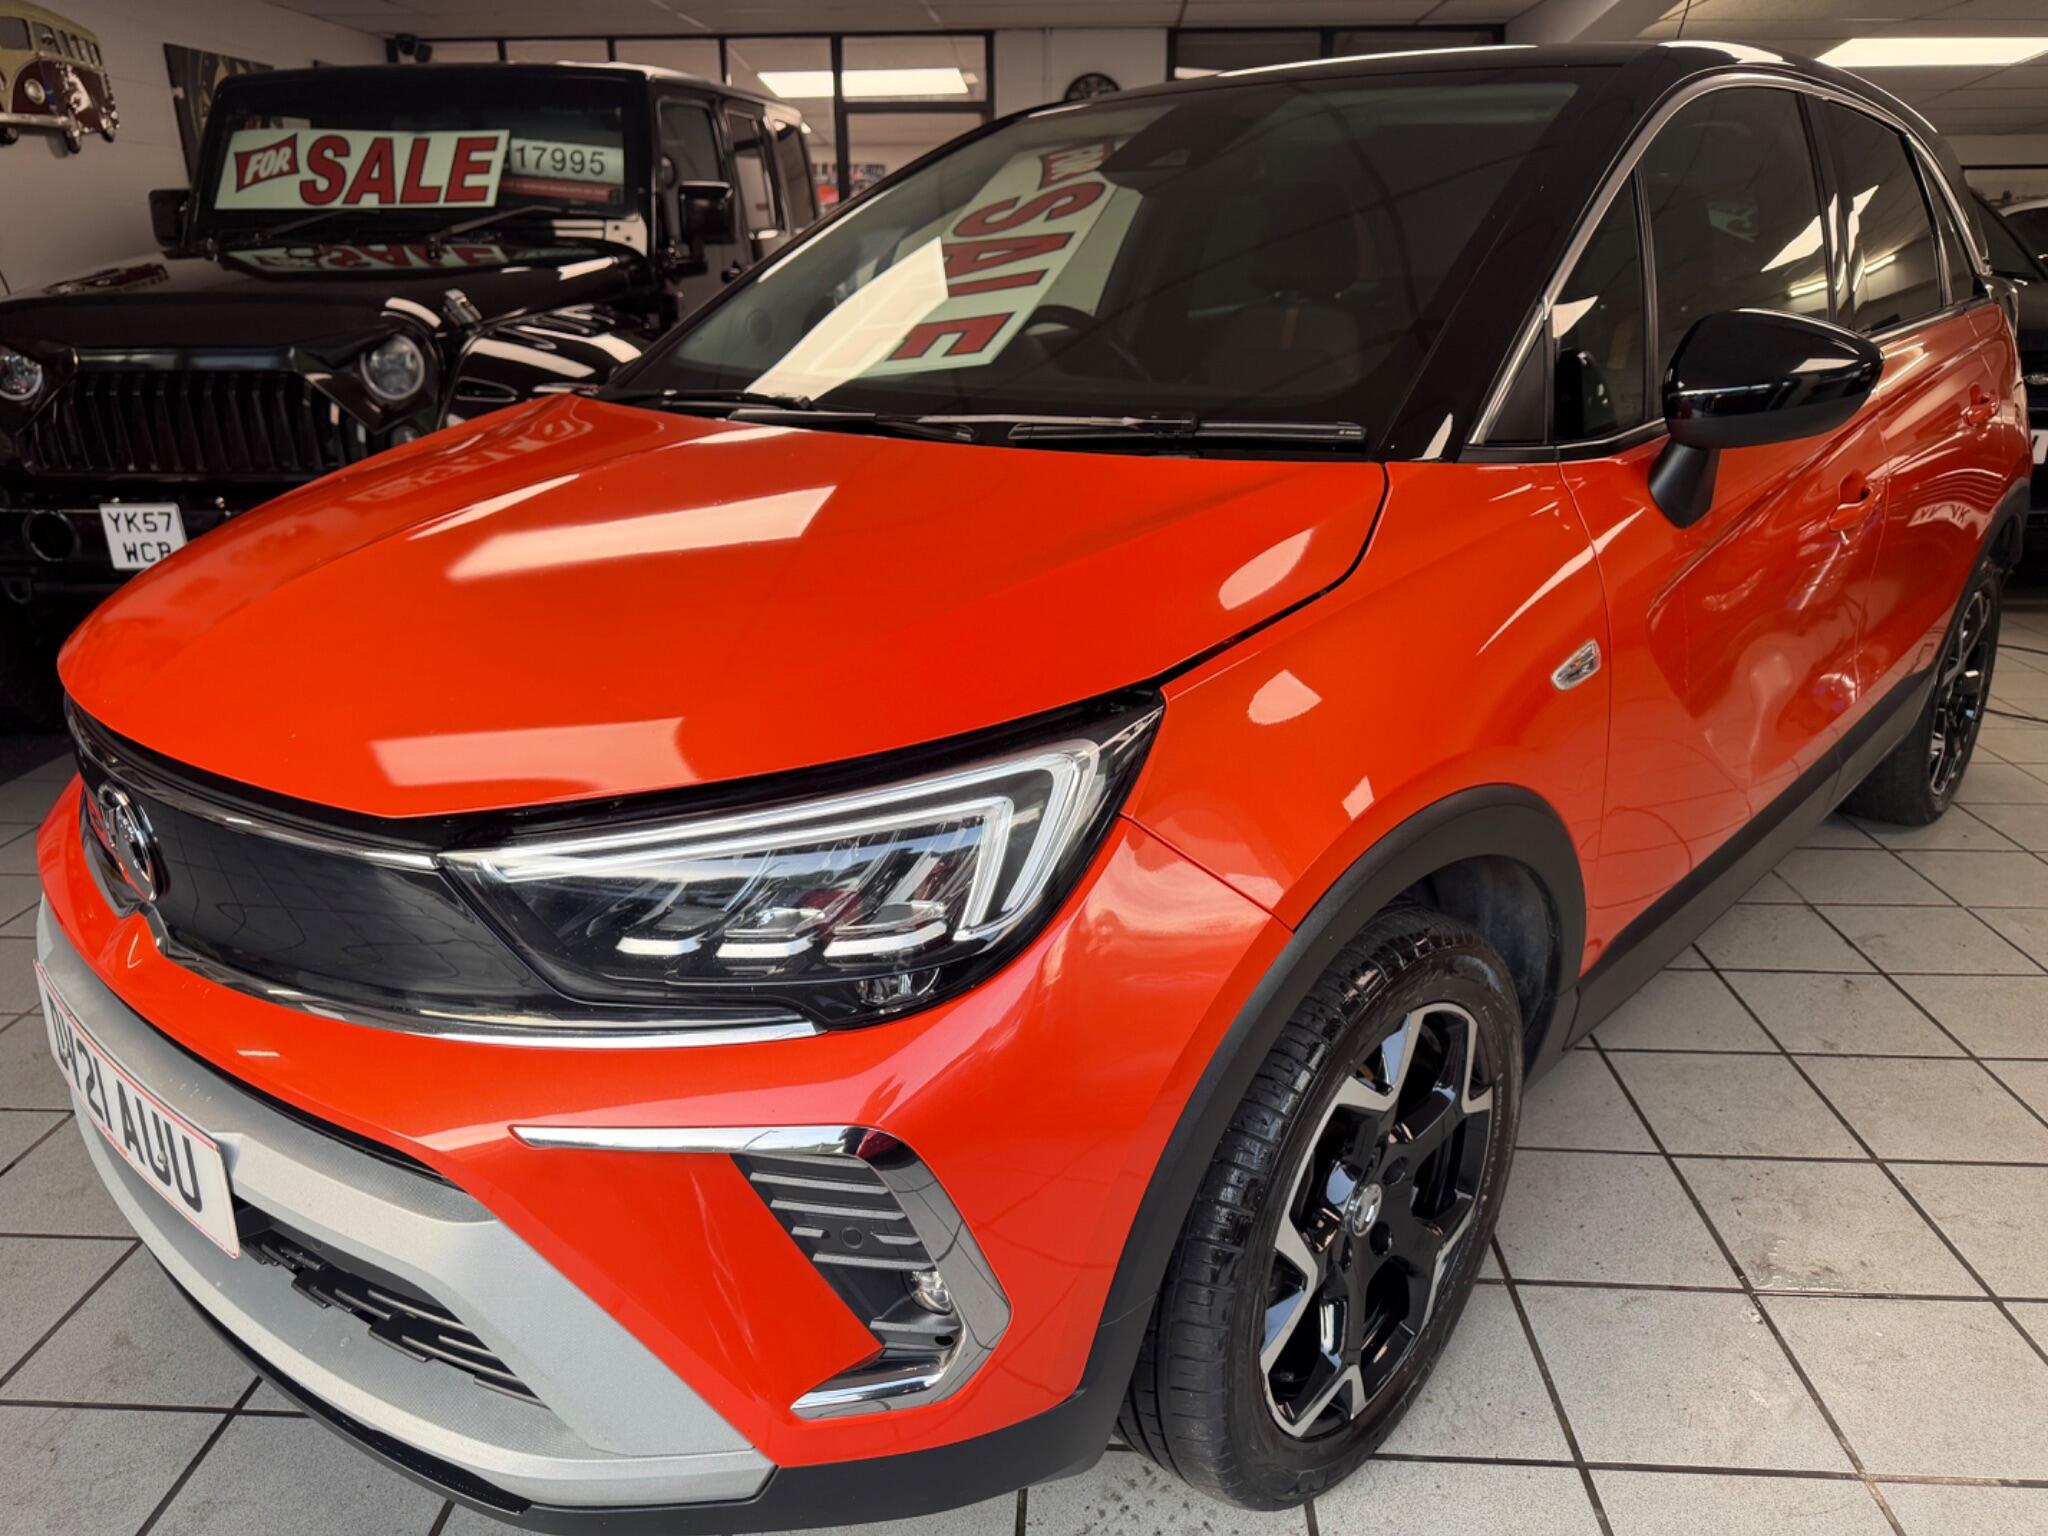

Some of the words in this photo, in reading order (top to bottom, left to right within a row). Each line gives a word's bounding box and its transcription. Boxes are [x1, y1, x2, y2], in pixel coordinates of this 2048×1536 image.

[244, 145, 292, 185] FOR
[300, 134, 499, 206] SALE
[515, 145, 605, 175] 17995
[107, 512, 172, 533] YK57
[116, 1078, 202, 1213] AUU
